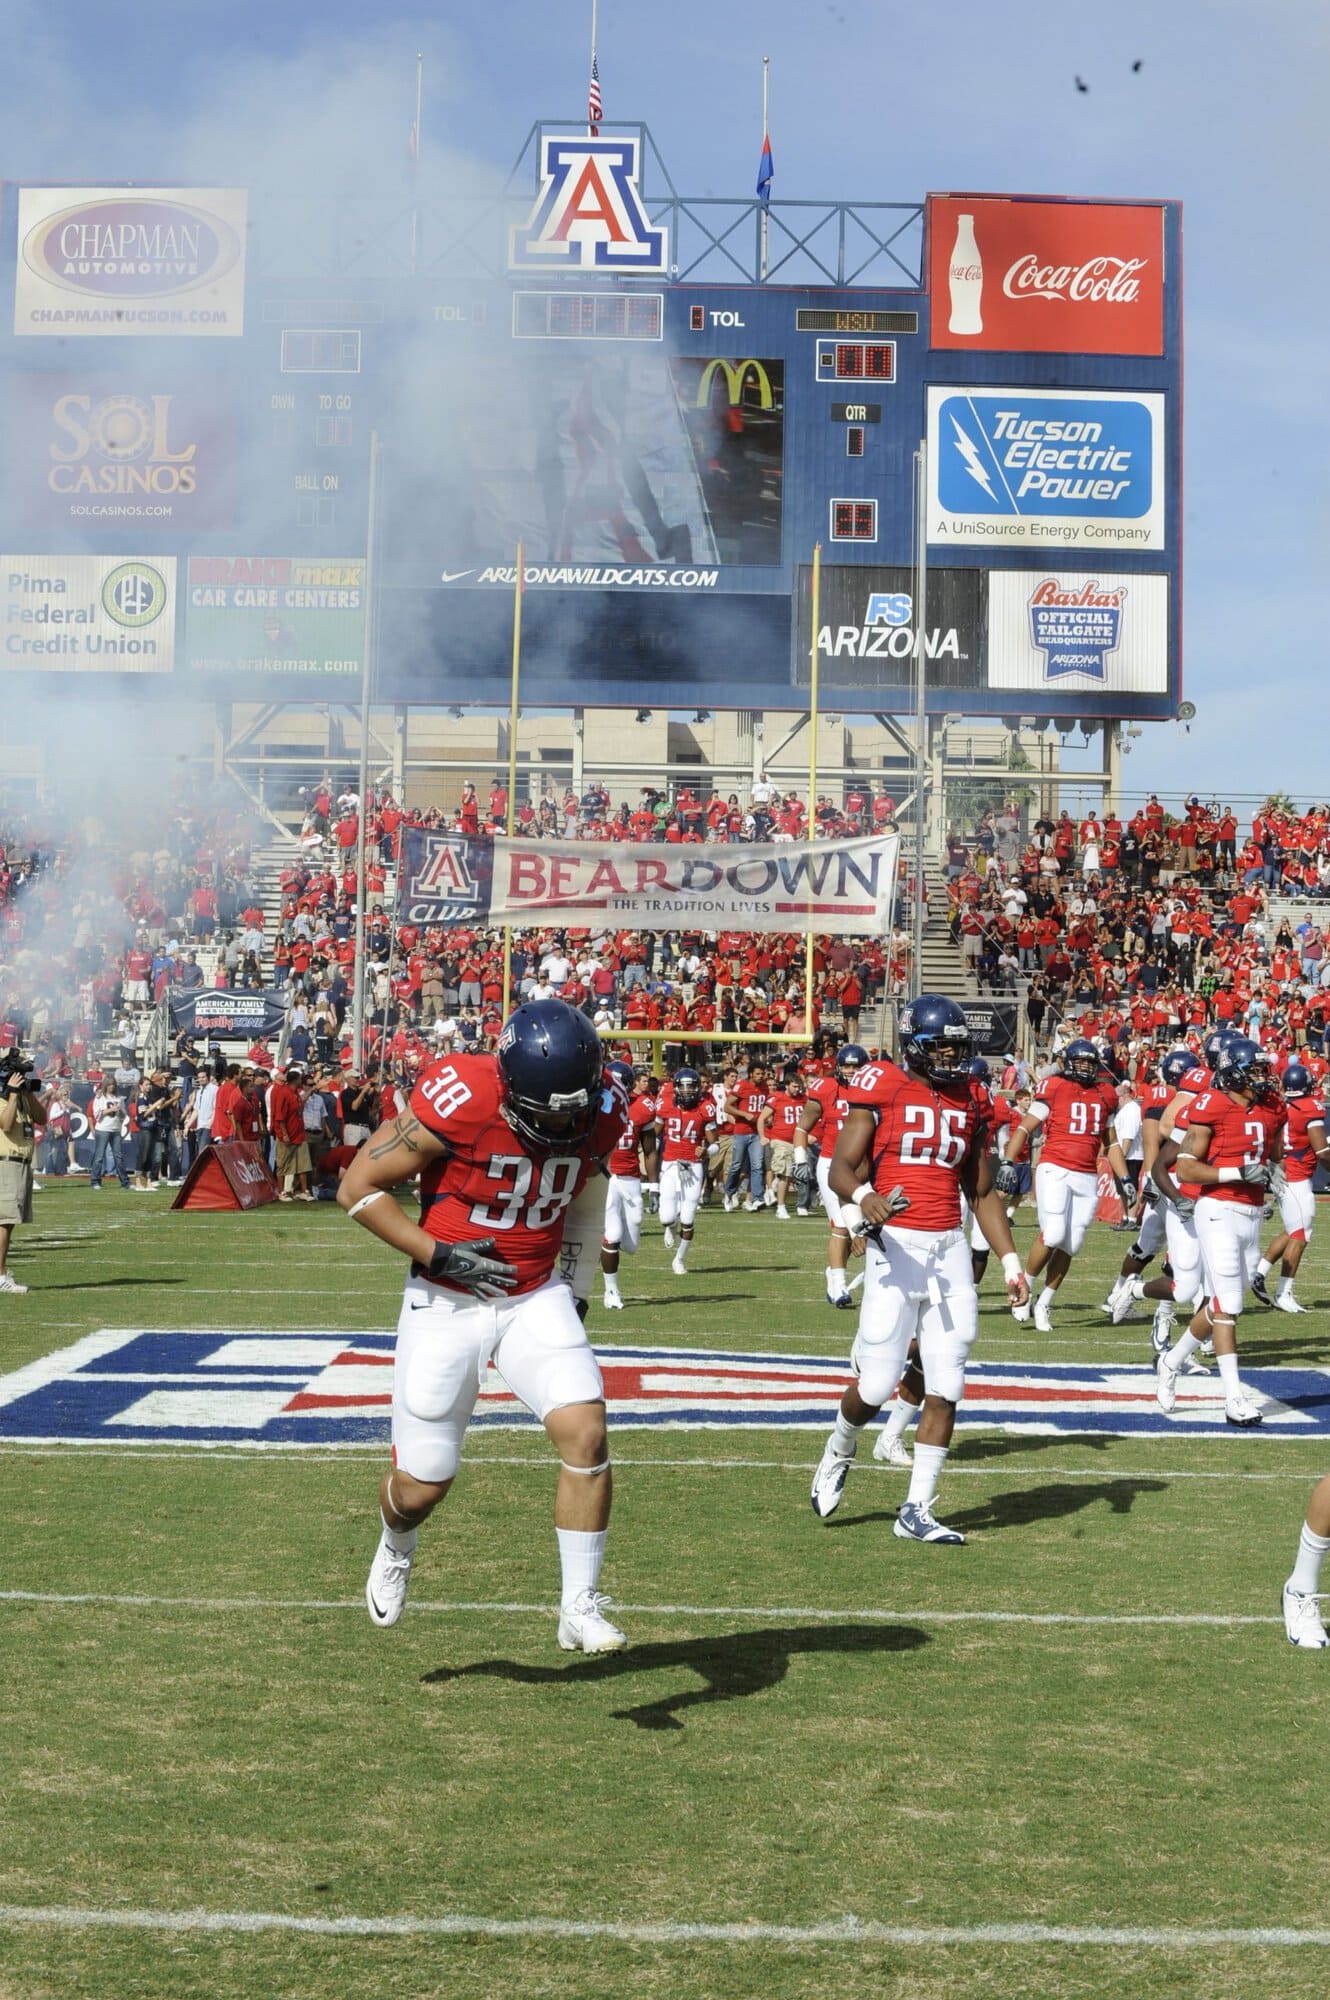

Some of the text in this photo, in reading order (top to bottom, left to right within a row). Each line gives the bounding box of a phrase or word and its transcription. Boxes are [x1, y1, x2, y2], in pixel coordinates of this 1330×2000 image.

[508, 136, 668, 272] A
[60, 224, 200, 259] CHAPMAN
[63, 262, 199, 275] AUTOMOTIVE
[1002, 254, 1149, 303] Coca-Cola
[432, 306, 468, 322] TOL
[709, 311, 745, 327] TOL
[836, 312, 875, 332] WSU
[319, 395, 352, 410] TO GO
[845, 405, 867, 421] QTR
[52, 393, 197, 463] SOL
[992, 411, 1102, 443] Tucson
[1003, 441, 1132, 472] Electric
[48, 465, 197, 494] CASINOS
[295, 476, 339, 491] BALL ON
[1016, 471, 1131, 501] Power
[70, 505, 173, 517] SOLCASINOS.COM
[937, 520, 1151, 542] A UniSource Energy Company
[7, 574, 67, 594] Pima
[191, 589, 360, 609] CAR CARE CENTERS
[865, 592, 913, 626] FS
[7, 604, 96, 625] Federal
[1037, 612, 1114, 625] OFFICIAL
[1037, 625, 1114, 637] TAILGATE
[6, 635, 157, 655] Credit Union
[809, 626, 960, 659] ARIZONA
[1038, 637, 1113, 646] HEADQUARTERS
[190, 656, 359, 673] www.brakemax.com
[1050, 654, 1100, 665] ARIZONA
[613, 899, 771, 914] THE TRADITION LIVES
[196, 1000, 265, 1008] AMERICAN FAMILY
[420, 1065, 472, 1120] 38
[1151, 1086, 1167, 1100] 70
[1195, 1092, 1212, 1111] 3
[1067, 1101, 1102, 1136] 91
[668, 1117, 698, 1144] 24
[897, 1105, 968, 1169] 26
[1243, 1121, 1265, 1166] 3
[468, 1154, 583, 1231] 38
[560, 1240, 583, 1281] BEA
